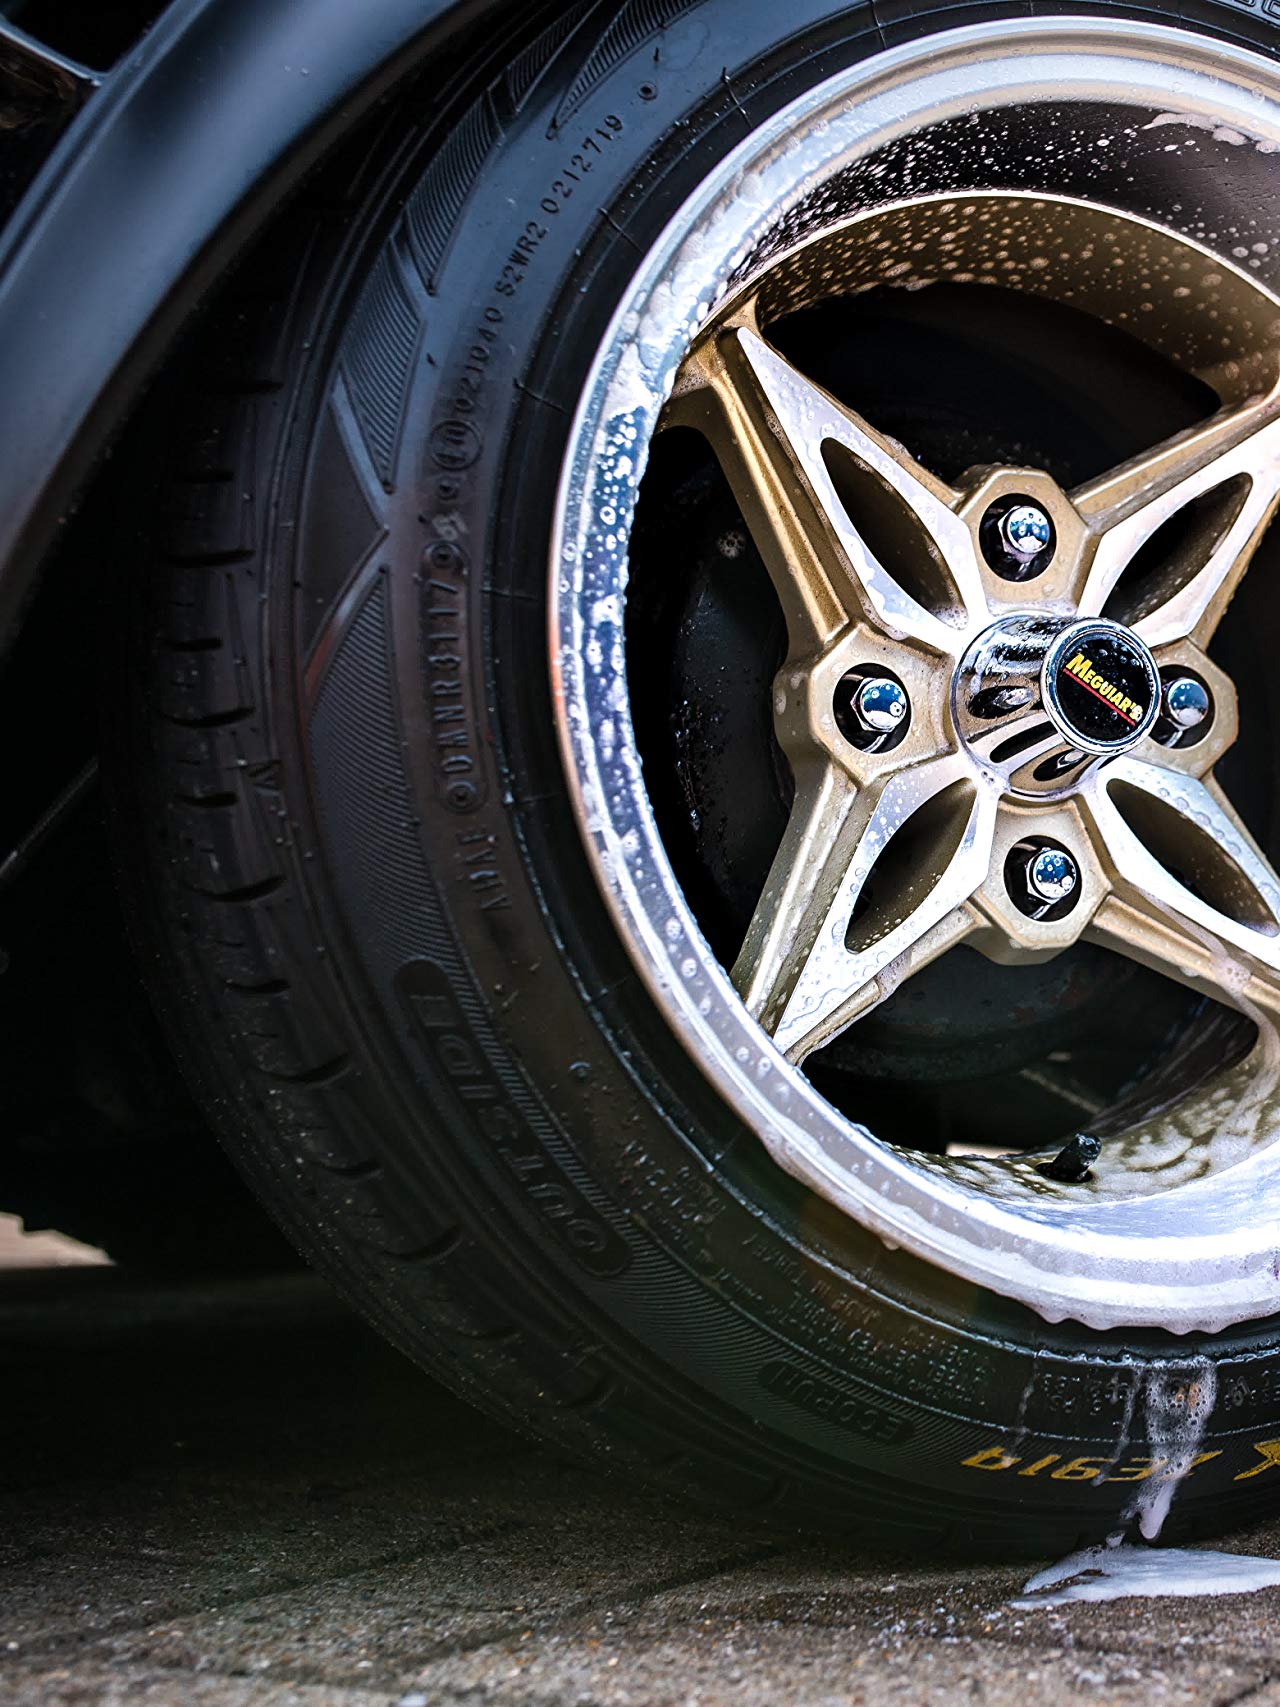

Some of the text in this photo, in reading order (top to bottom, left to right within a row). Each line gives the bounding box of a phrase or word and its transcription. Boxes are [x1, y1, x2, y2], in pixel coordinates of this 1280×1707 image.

[495, 221, 547, 296] S2WR2
[541, 114, 623, 214] 0212719
[1066, 653, 1143, 722] MEGUIAR'S
